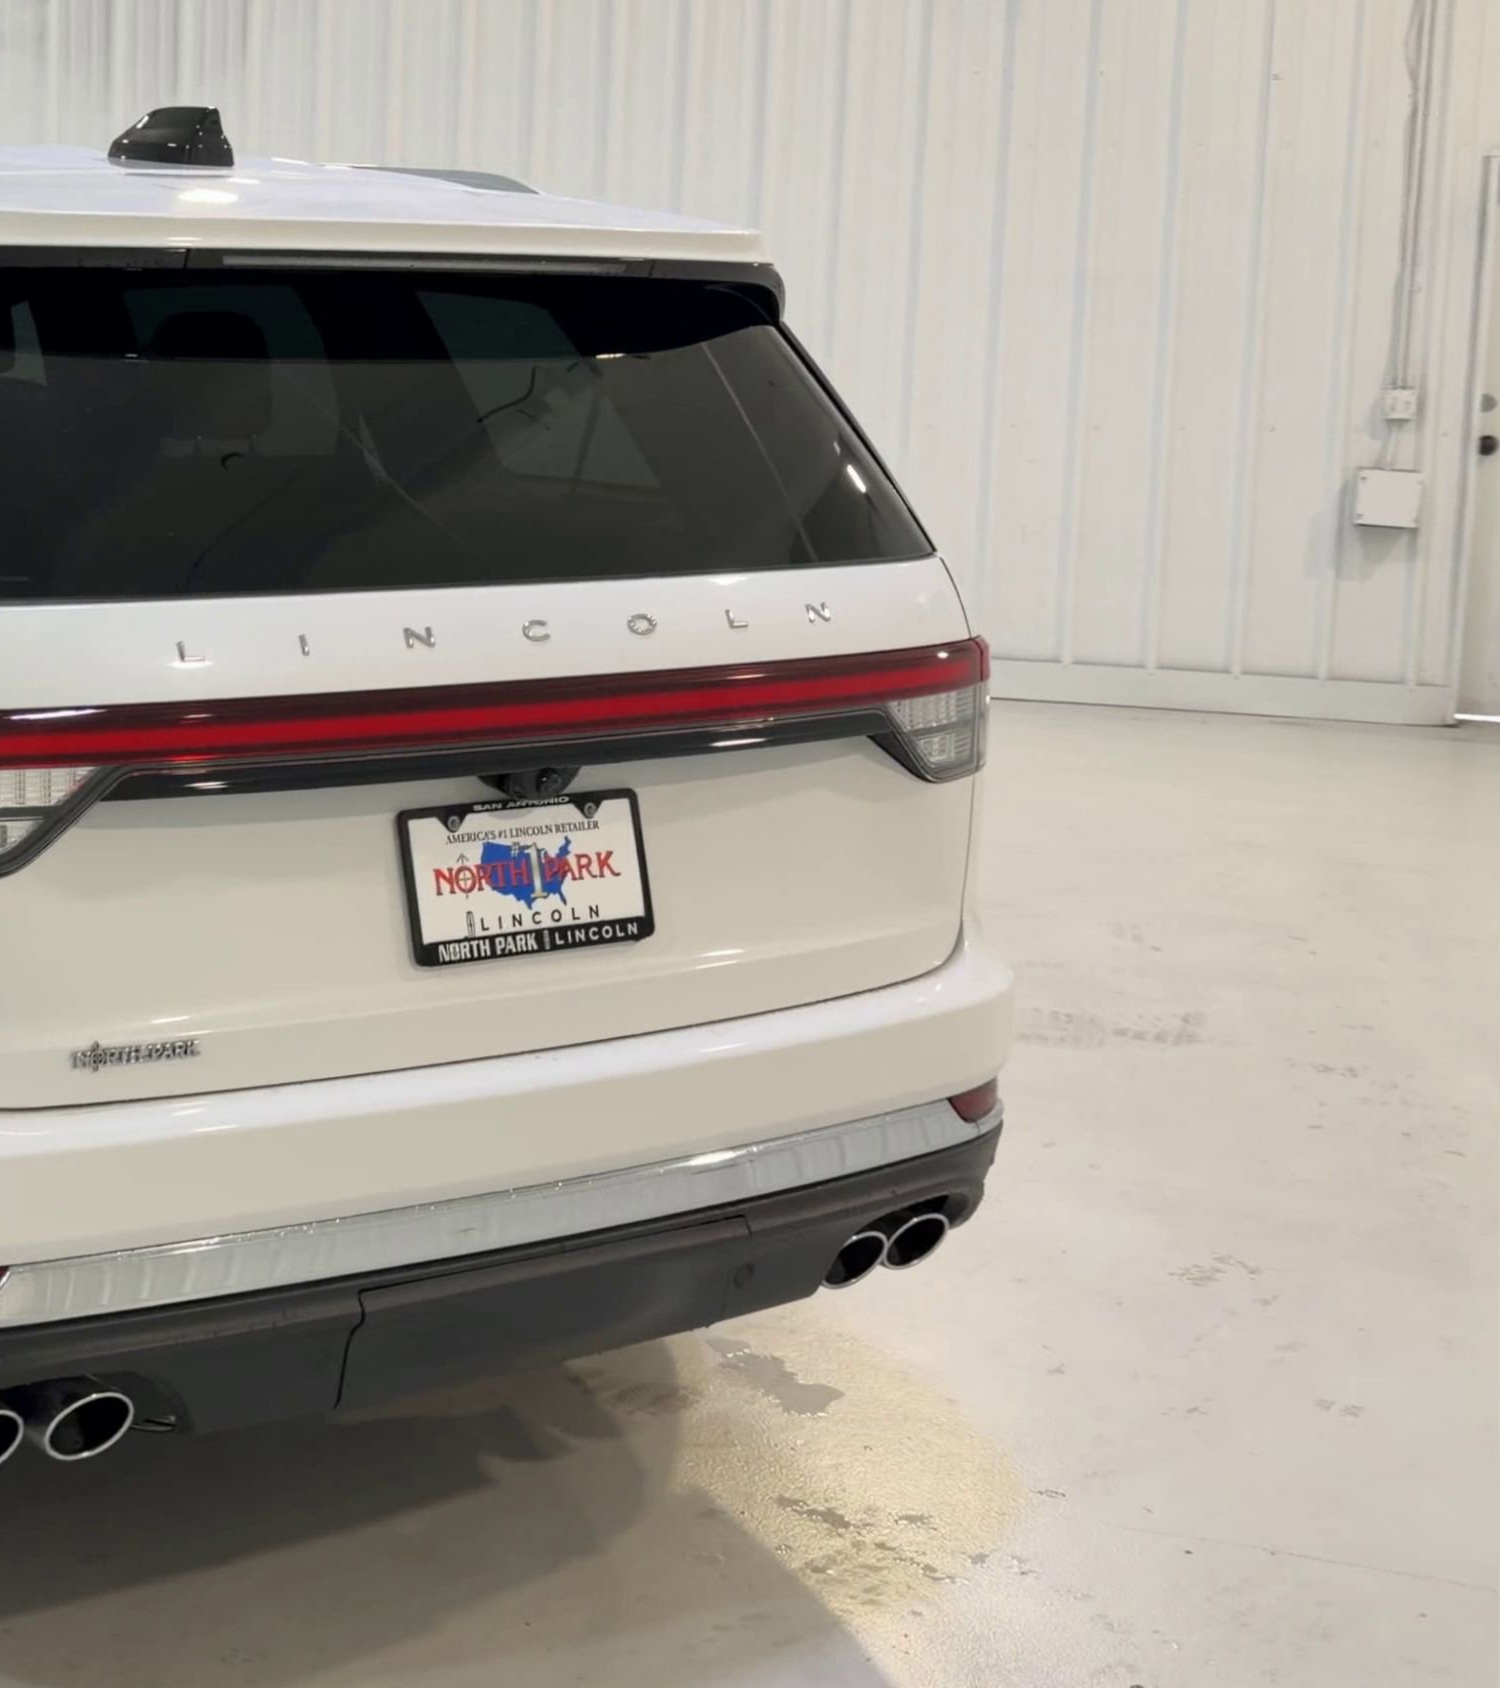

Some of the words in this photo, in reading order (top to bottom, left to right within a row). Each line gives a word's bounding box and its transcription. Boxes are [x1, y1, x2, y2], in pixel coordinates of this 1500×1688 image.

[176, 602, 832, 664] LINCOLN
[472, 803, 503, 812] SAN
[505, 796, 570, 809] ANTONIO
[445, 829, 496, 845] AMERICA'S
[498, 829, 509, 840] #1
[509, 824, 553, 839] LINCOLN
[554, 820, 600, 834] RETAILER
[432, 858, 531, 896] NORTH
[543, 851, 621, 882] PARK
[480, 904, 600, 932] LINCOLN
[438, 937, 491, 963] NORTH
[494, 933, 538, 955] PARK
[555, 922, 639, 945] LINCOLN
[70, 1043, 142, 1070] NORTH
[147, 1039, 202, 1059] PARK
